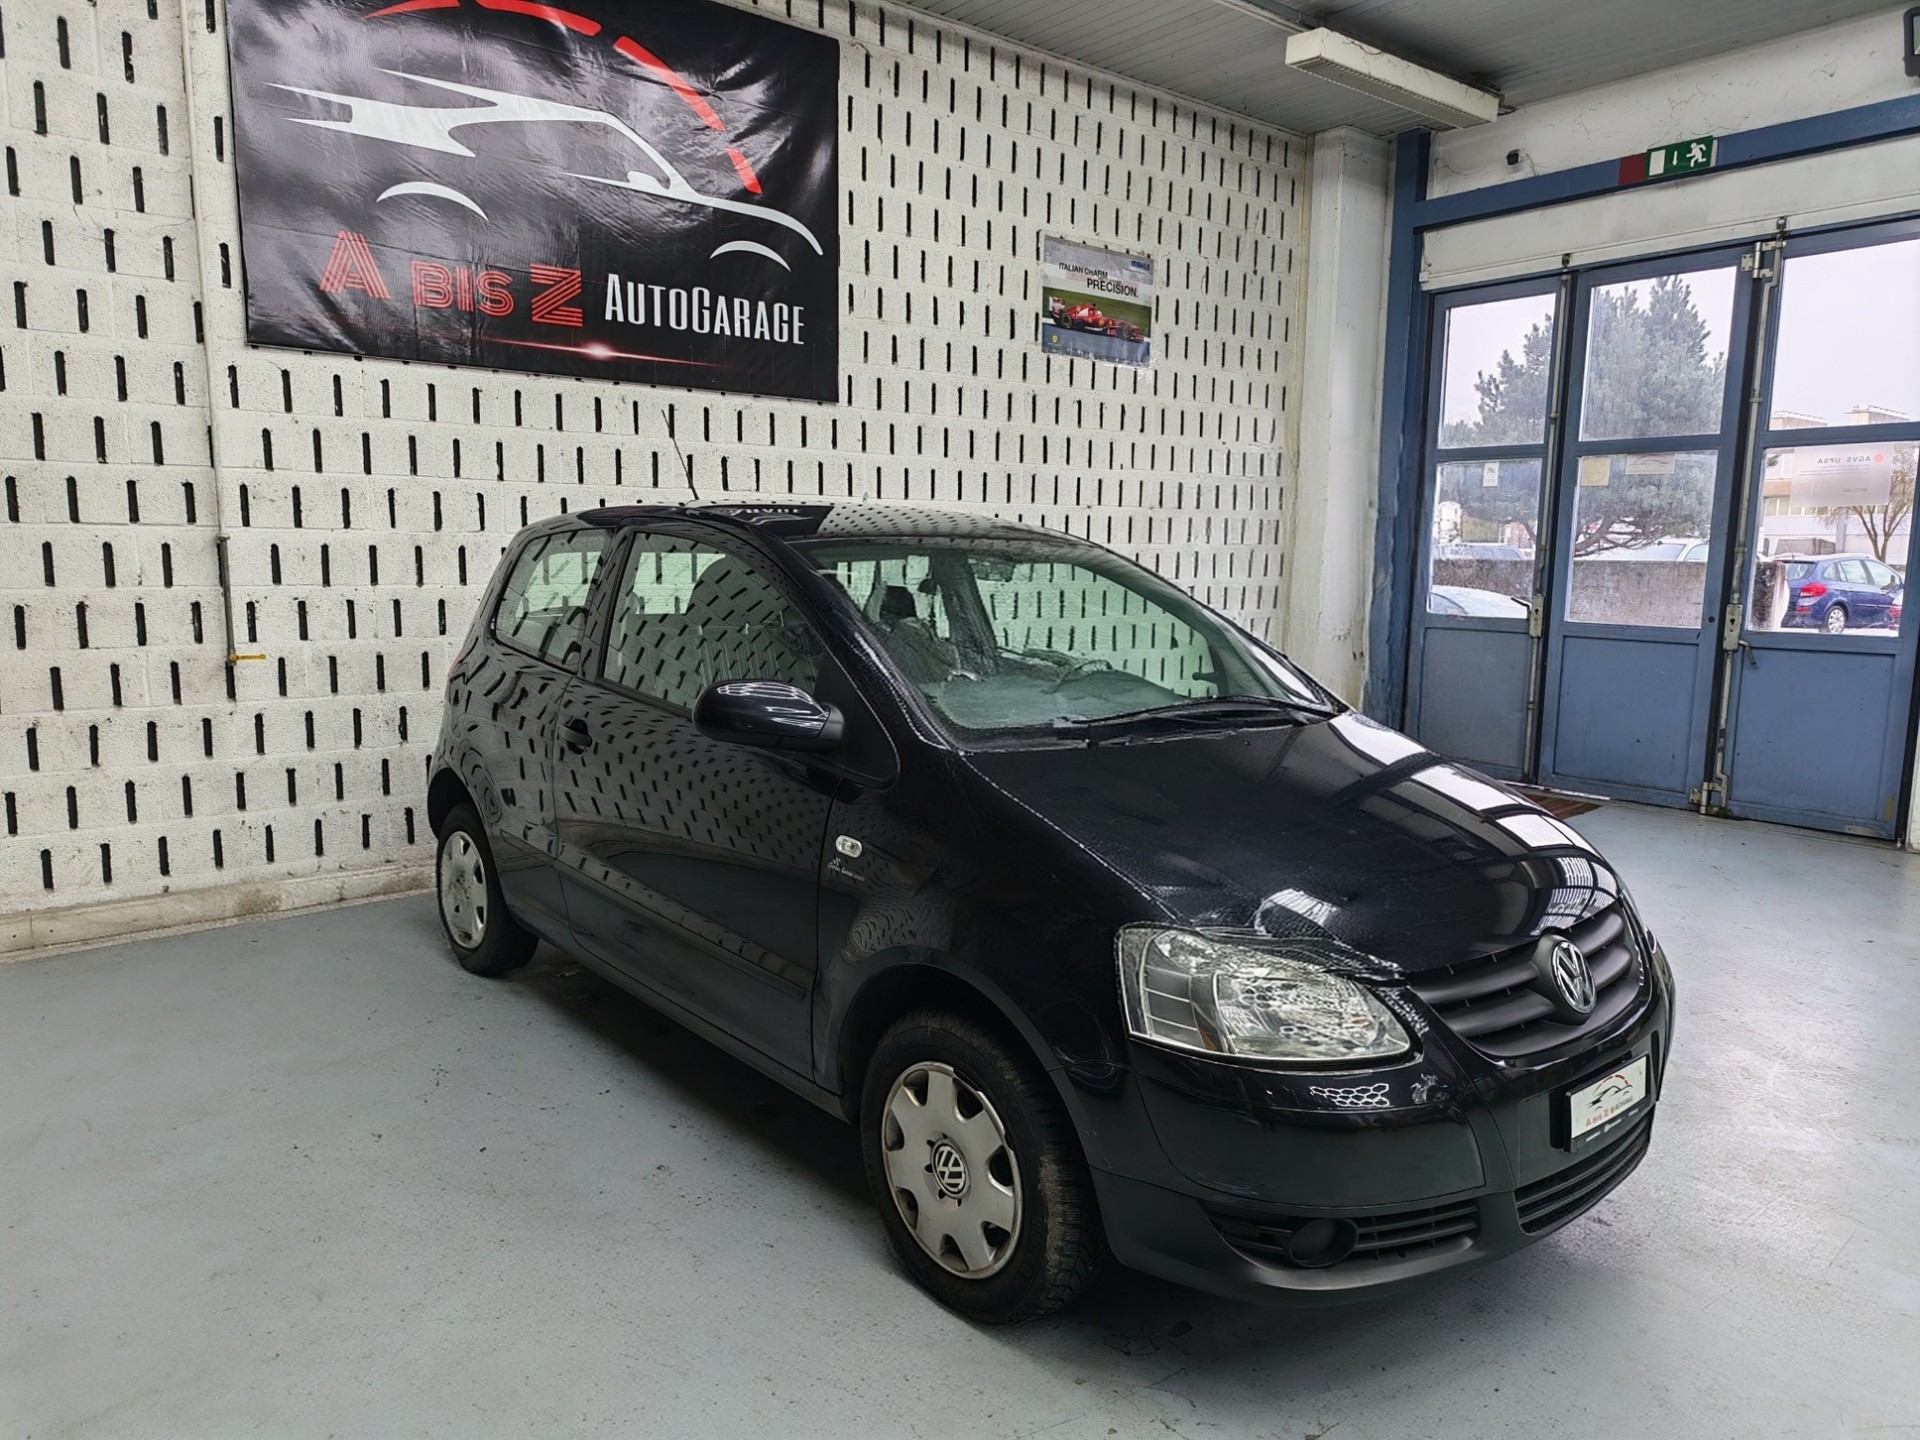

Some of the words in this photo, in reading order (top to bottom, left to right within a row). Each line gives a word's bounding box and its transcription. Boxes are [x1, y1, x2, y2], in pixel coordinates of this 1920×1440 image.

[1058, 262, 1084, 274] ITALIAN
[1084, 267, 1108, 278] CHARM
[319, 230, 390, 299] A
[410, 260, 515, 317] BIS
[530, 263, 584, 328] Z
[604, 272, 806, 346] AUTOGARAGE
[1086, 278, 1139, 298] PRECISION.
